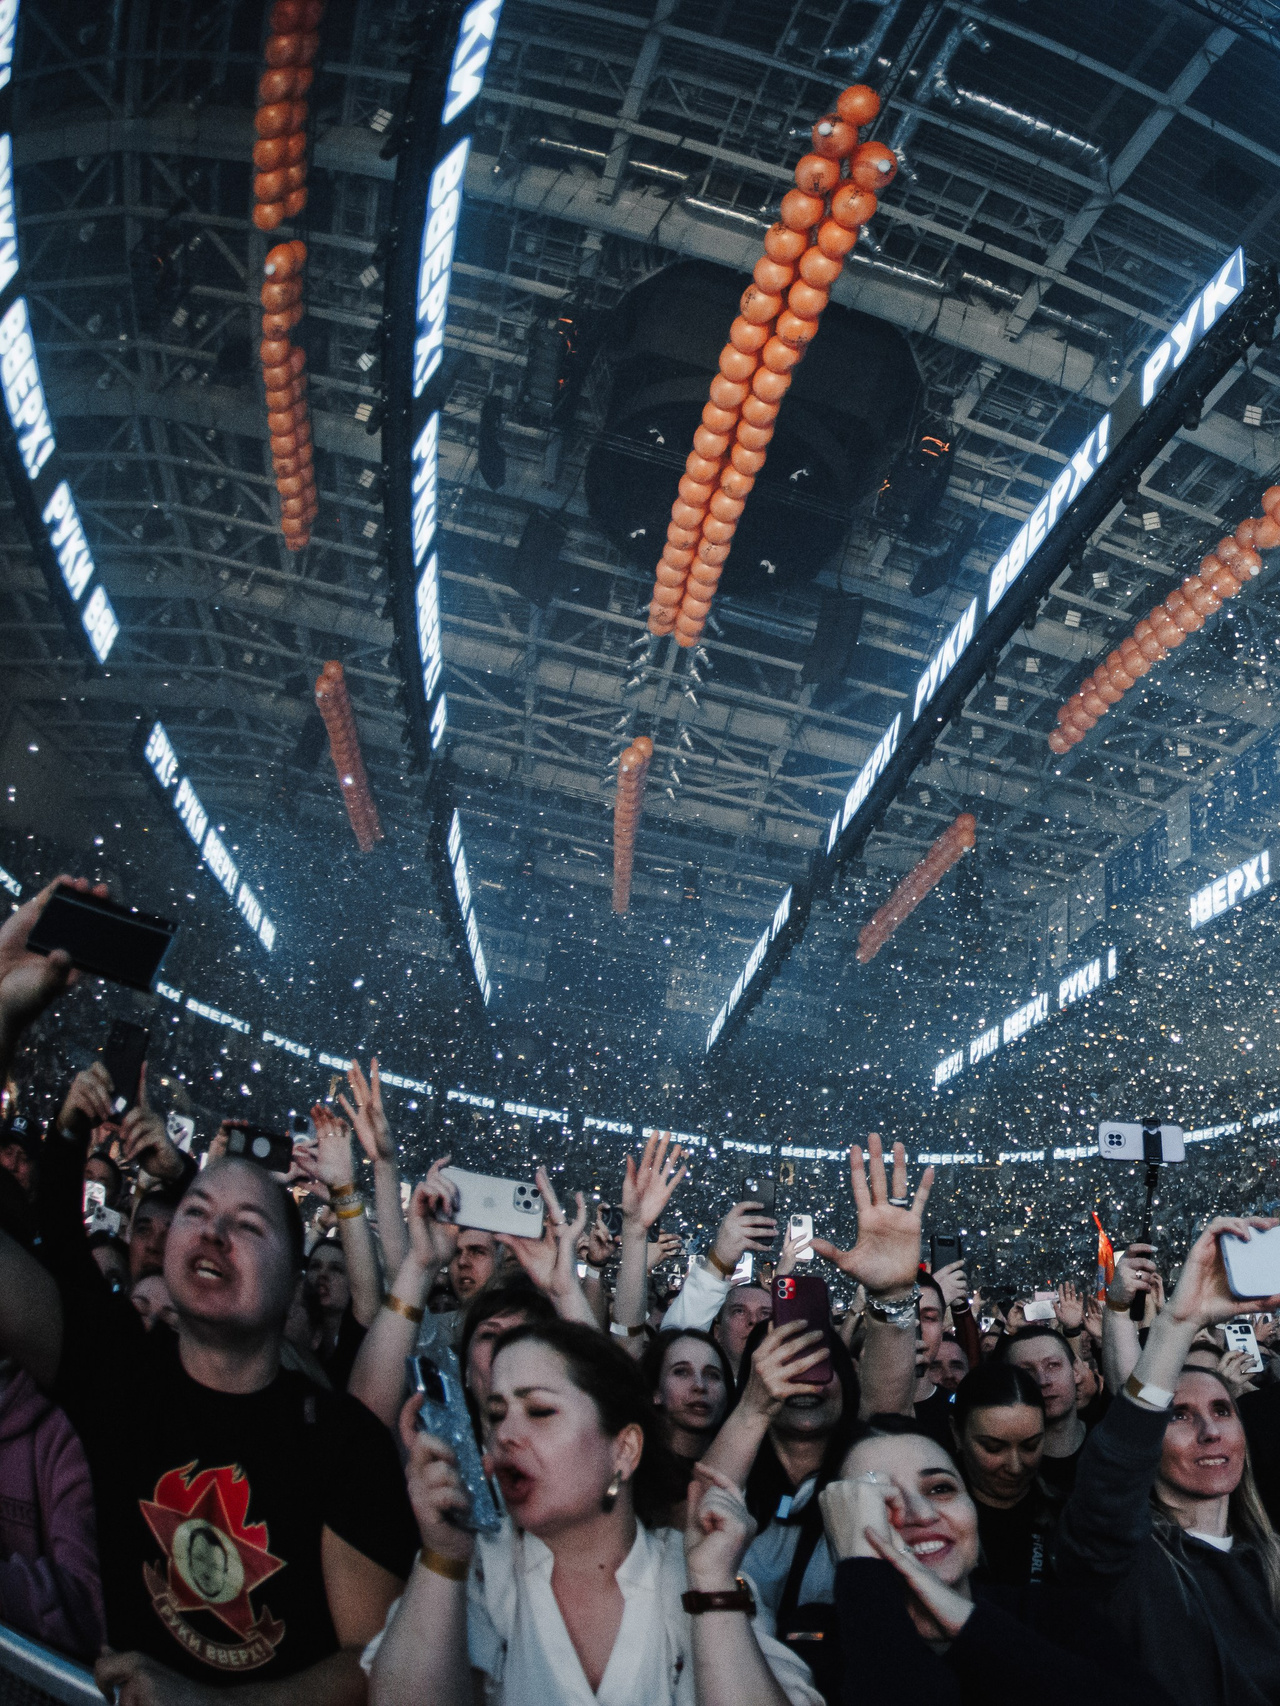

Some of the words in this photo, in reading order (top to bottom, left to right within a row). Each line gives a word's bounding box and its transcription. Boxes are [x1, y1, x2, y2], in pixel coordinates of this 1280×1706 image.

[413, 139, 470, 398] ВВЕРХ!
[0, 297, 55, 478] ВВЕРХ!
[43, 481, 95, 600] РУКИ
[412, 412, 439, 566] РУКИ
[842, 712, 901, 831] ВВЕРХ!
[914, 597, 978, 721] РУКИ
[988, 414, 1111, 612] ВВЕРХ!
[1143, 247, 1246, 406] РУК
[174, 777, 208, 844] РУКИ
[185, 998, 250, 1034] ВВЕРХ!
[262, 1031, 311, 1059] РУКИ
[371, 1068, 433, 1095] ВЕРХ!
[446, 1090, 496, 1109] РУКИ
[503, 1102, 569, 1123] ВВЕРХ!
[583, 1116, 634, 1134] РУКИ
[722, 1140, 772, 1155] РУКИ
[780, 1146, 847, 1161] ВВЕРХ!
[917, 1153, 984, 1164] ВВЕРХ!
[1000, 1151, 1045, 1163] РУКИ
[970, 1025, 999, 1064] РУКИ
[1003, 992, 1048, 1044] ВВЕРХ!
[1059, 958, 1100, 1009] РУКИ
[160, 1605, 201, 1651] РУКИ
